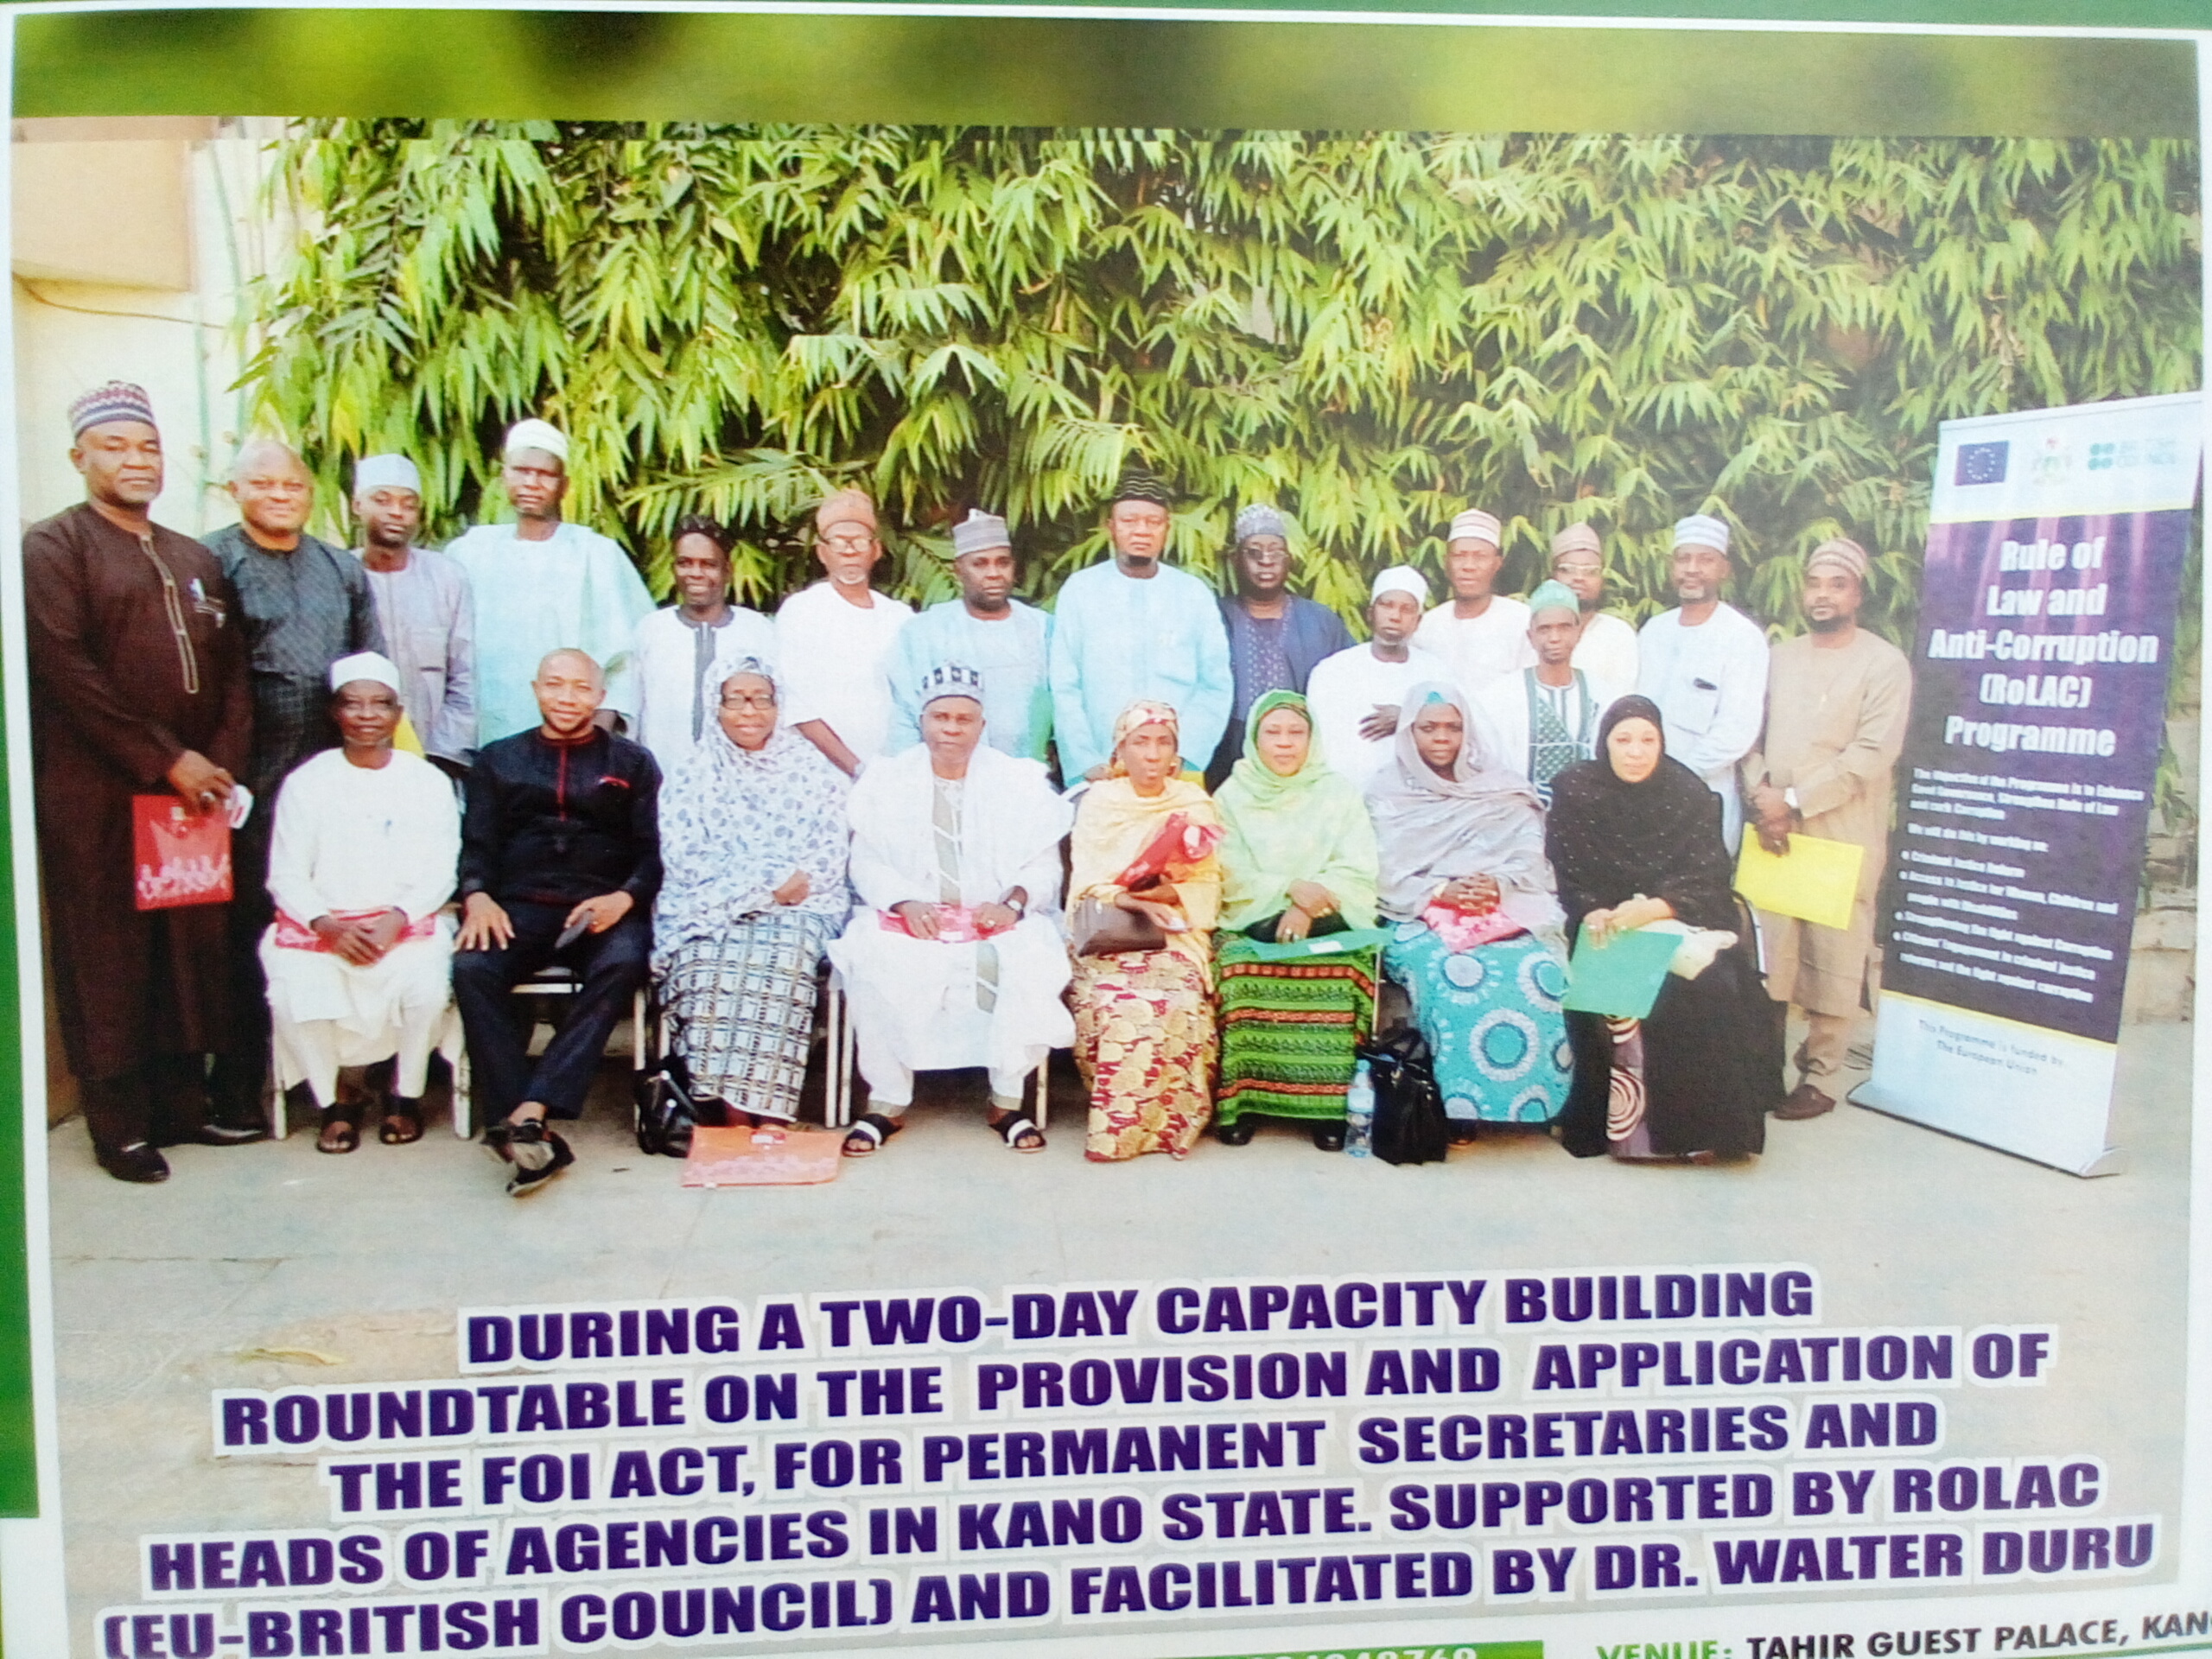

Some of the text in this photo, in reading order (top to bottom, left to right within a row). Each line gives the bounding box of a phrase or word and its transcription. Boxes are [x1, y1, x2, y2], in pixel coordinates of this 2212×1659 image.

[2000, 536, 2106, 572] Rule of
[1986, 583, 2108, 616] Law and
[1928, 628, 2159, 665] Anti-Corruption
[1979, 672, 2093, 709] (RoLAC)
[1944, 715, 2116, 757] Programme
[1940, 1025, 1995, 1049] Programme
[469, 1272, 1811, 1363] DURING A TWO-DAY CAPACITY BUILDING
[224, 1334, 2048, 1445] ROUNDTABLE ON THE PROVISION AND APPLICATION OF
[330, 1403, 1936, 1511] THE FOI ACT, FOR PERMANENT SECRETARIES AND
[151, 1465, 2097, 1590] HEADS OF AGENCIES IN KANO STATE. SUPPORTED BY ROLAC
[105, 1525, 2152, 1659] (EU-BRITISH COUNCIL) AND FACILITATED BY DR. WALTER DURU
[1596, 1610, 2212, 1659] VENUE: TAHIR GUEST PALACE, KAN
